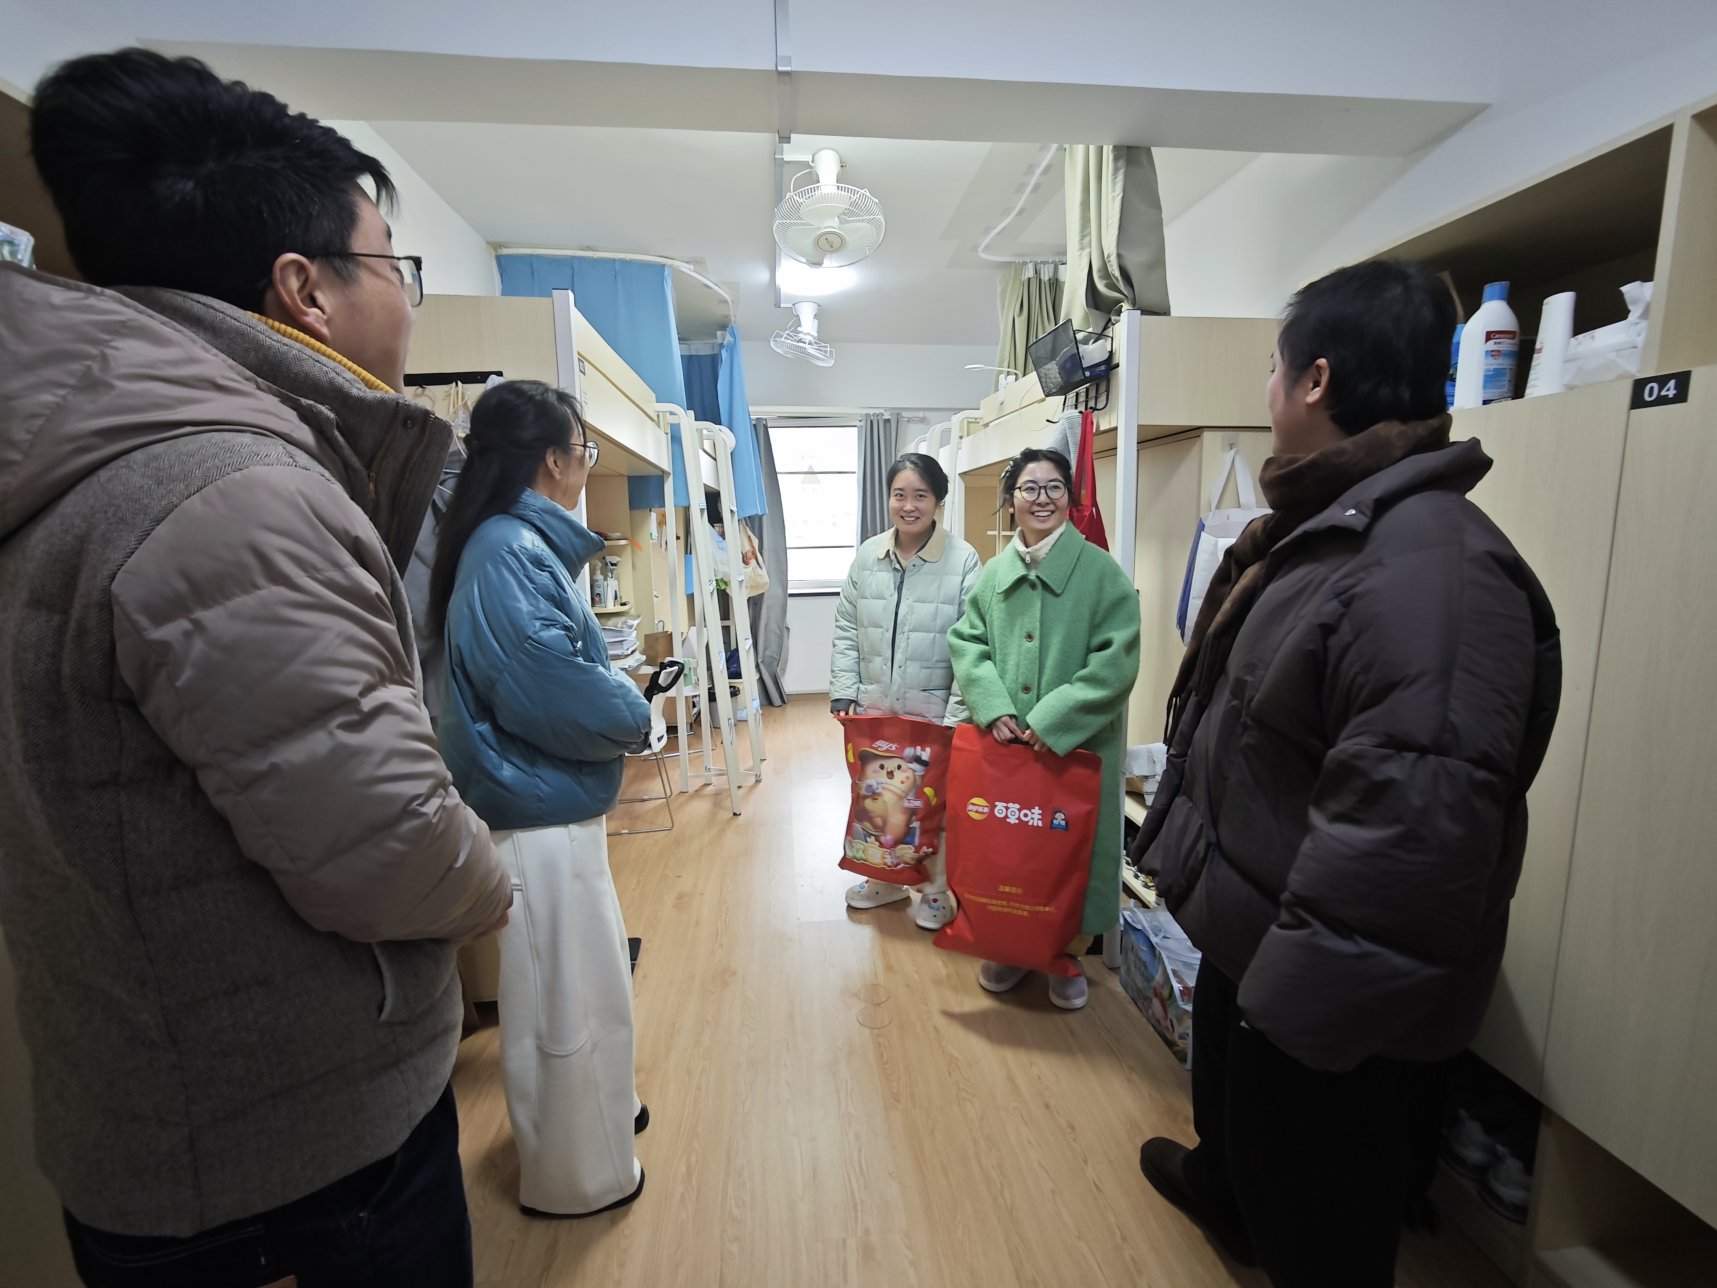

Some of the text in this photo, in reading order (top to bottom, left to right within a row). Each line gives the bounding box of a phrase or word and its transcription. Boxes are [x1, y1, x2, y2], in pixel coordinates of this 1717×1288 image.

[1644, 379, 1677, 402] 04
[994, 801, 1043, 827] 百草味
